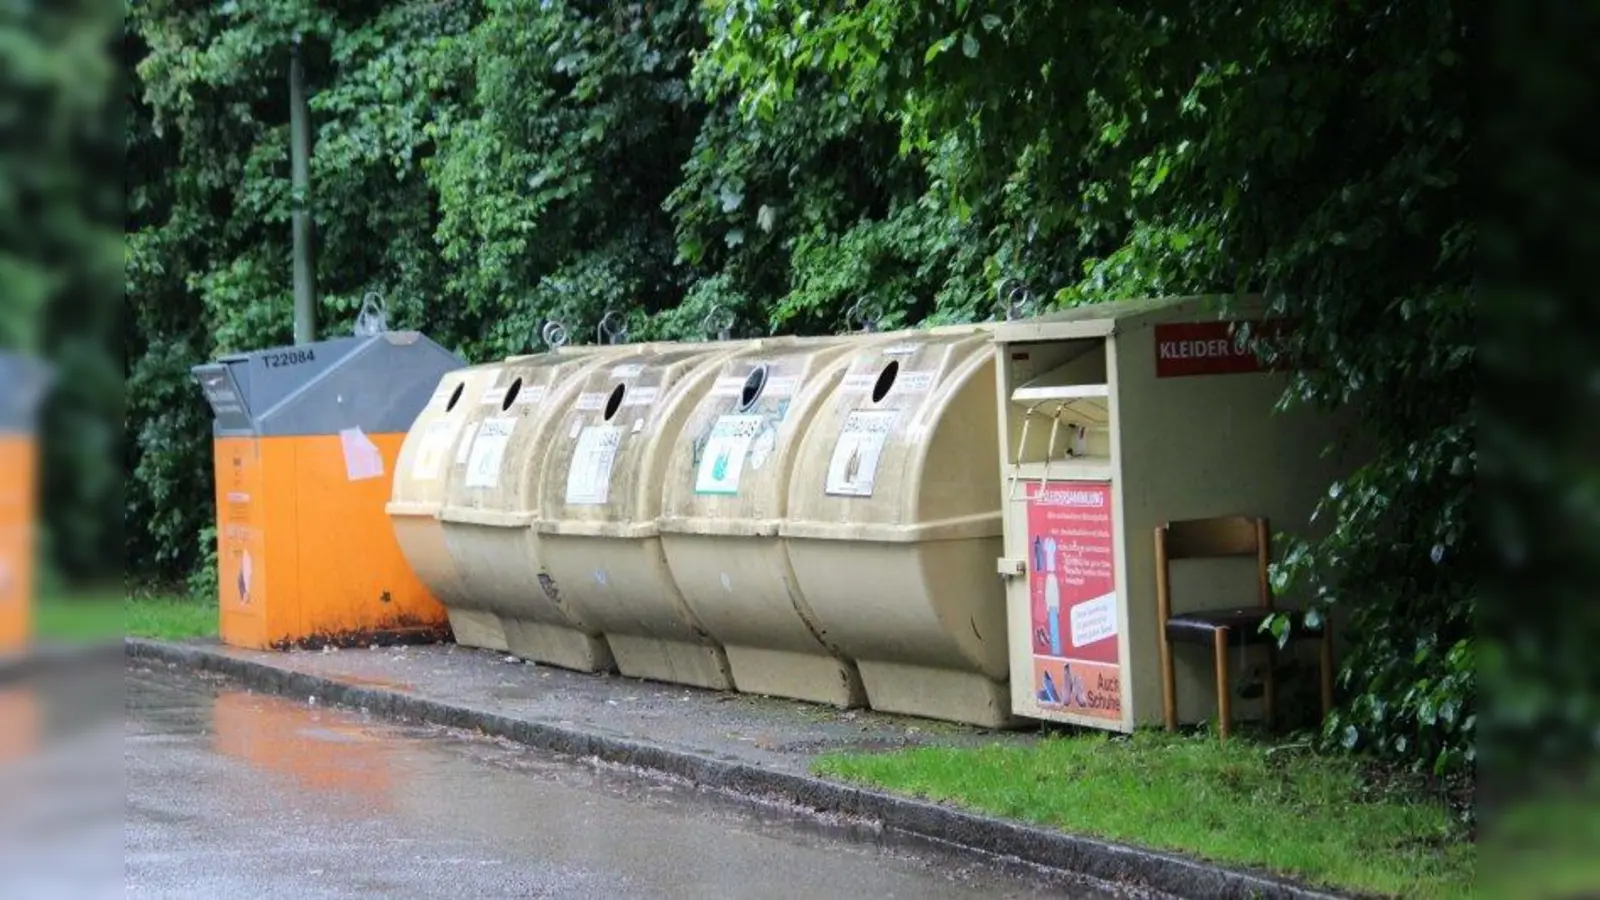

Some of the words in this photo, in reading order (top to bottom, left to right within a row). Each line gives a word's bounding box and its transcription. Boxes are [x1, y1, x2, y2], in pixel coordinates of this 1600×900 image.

[262, 349, 316, 368] T22084
[1159, 339, 1230, 359] KLEIDER
[1096, 671, 1120, 692] Auch
